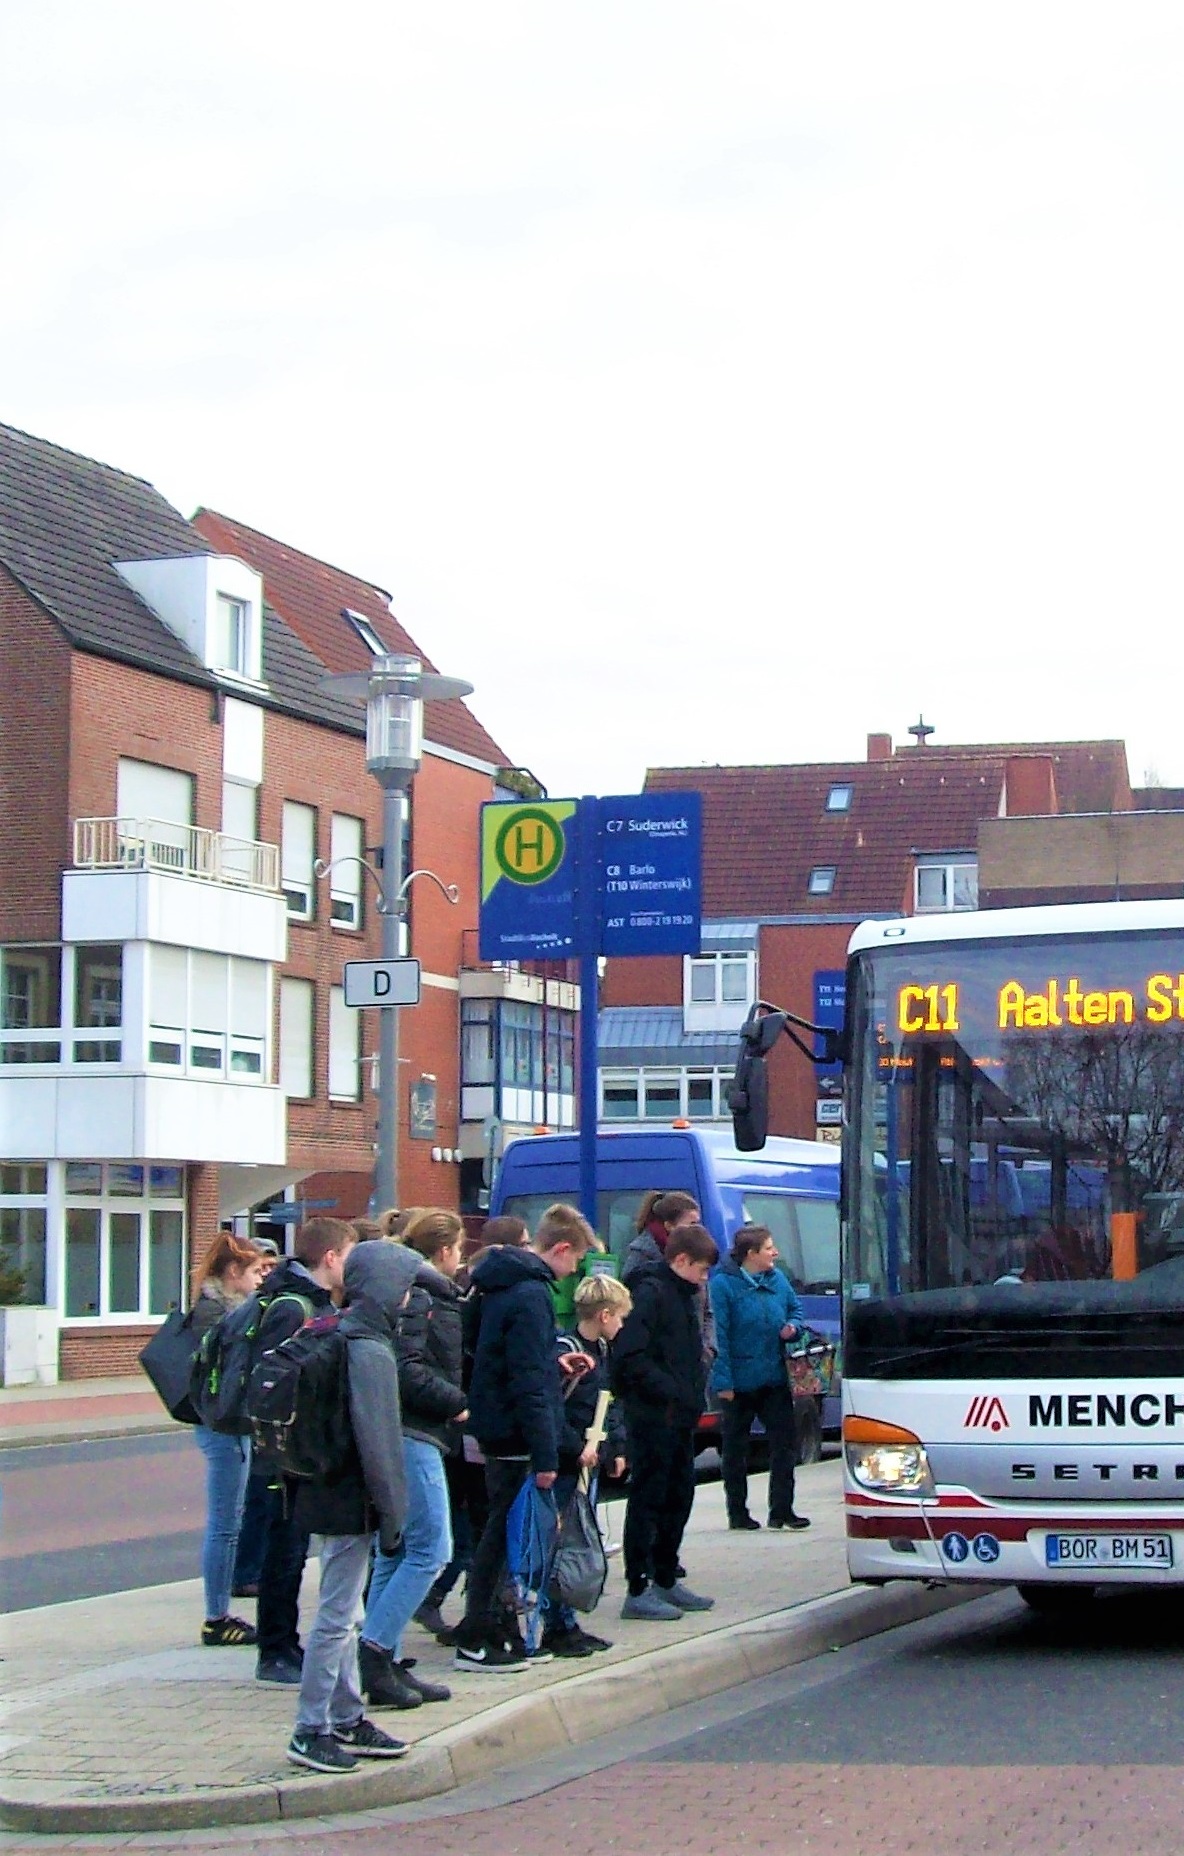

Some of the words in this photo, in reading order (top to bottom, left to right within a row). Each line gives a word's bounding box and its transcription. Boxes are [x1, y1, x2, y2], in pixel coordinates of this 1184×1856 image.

[606, 819, 624, 832] C7
[515, 824, 544, 867] H
[606, 865, 621, 876] C8
[629, 864, 656, 875] Barlo
[606, 880, 629, 893] (T10
[629, 877, 692, 892] Winterswijk)
[607, 917, 625, 928] AST
[374, 970, 391, 997] D
[899, 984, 960, 1031] C11
[999, 979, 1134, 1028] Aalten
[1059, 1539, 1098, 1559] BOR
[1112, 1539, 1138, 1559] BM
[1143, 1538, 1168, 1558] 51
